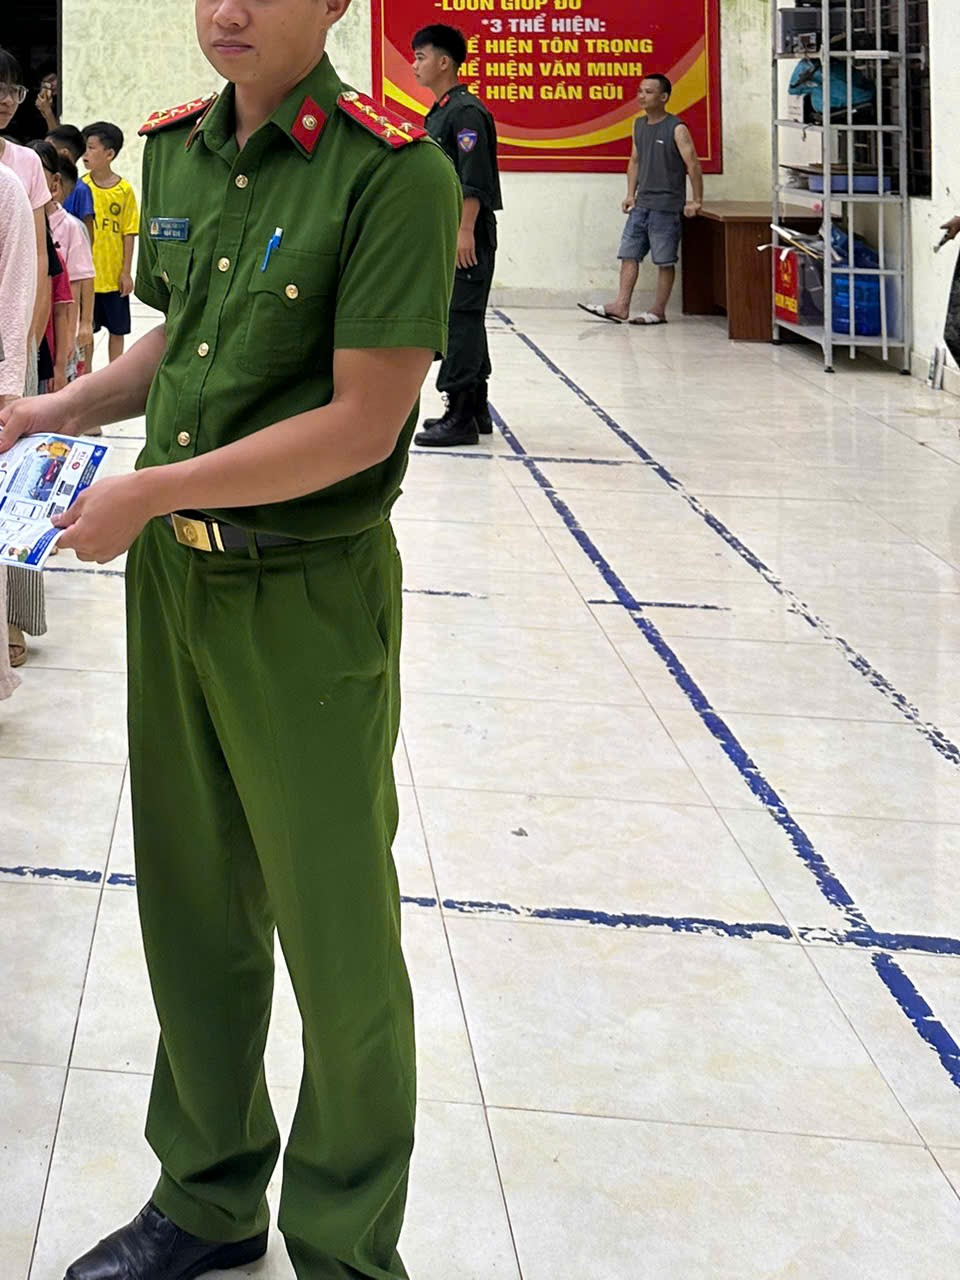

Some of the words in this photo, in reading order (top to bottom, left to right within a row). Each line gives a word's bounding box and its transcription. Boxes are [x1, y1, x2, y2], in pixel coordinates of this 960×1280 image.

[508, 13, 546, 32] THỂ
[552, 16, 605, 35] HIỆN:
[486, 37, 532, 56] HIỆN
[539, 32, 580, 53] TÔN
[585, 39, 652, 56] TRỌNG
[457, 58, 480, 76] HỂ
[486, 60, 533, 79] HIỆN
[540, 60, 580, 76] VĂN
[588, 63, 642, 76] MINH
[486, 83, 533, 102] HIỆN
[540, 81, 582, 99] GẦN
[590, 84, 622, 99] GŨI
